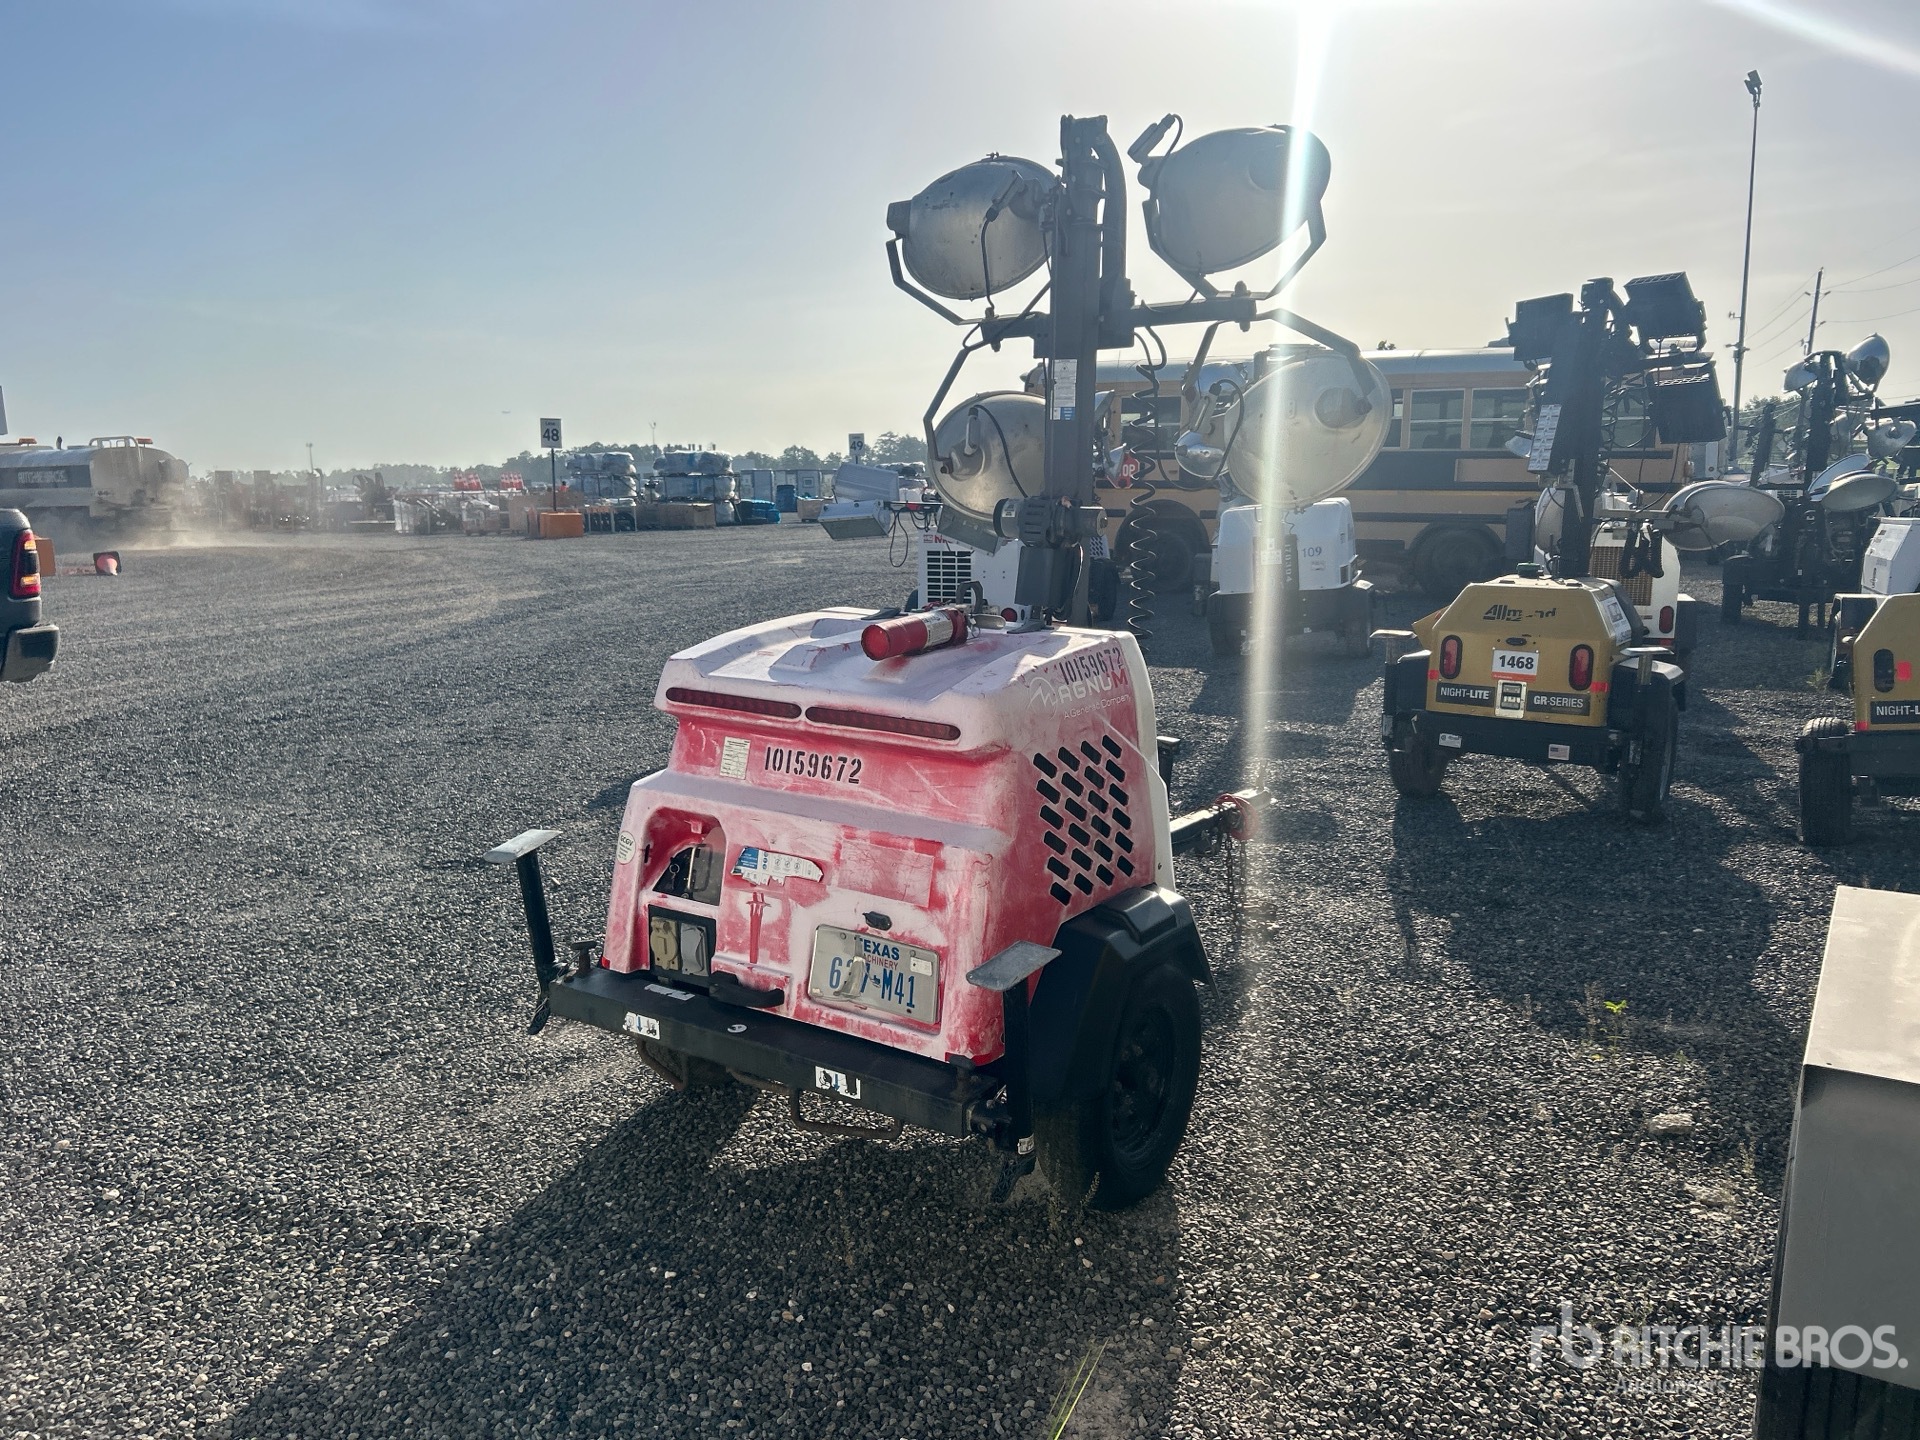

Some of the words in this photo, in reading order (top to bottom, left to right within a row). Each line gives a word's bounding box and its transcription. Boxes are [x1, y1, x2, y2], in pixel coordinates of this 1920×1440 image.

[543, 428, 560, 441] 48
[850, 440, 863, 450] 49
[1302, 546, 1322, 558] 109
[1499, 654, 1534, 670] 1468
[1440, 686, 1490, 700] NIGHT-LITE
[1533, 695, 1584, 708] GR-SERIES
[765, 746, 862, 785] 10159672
